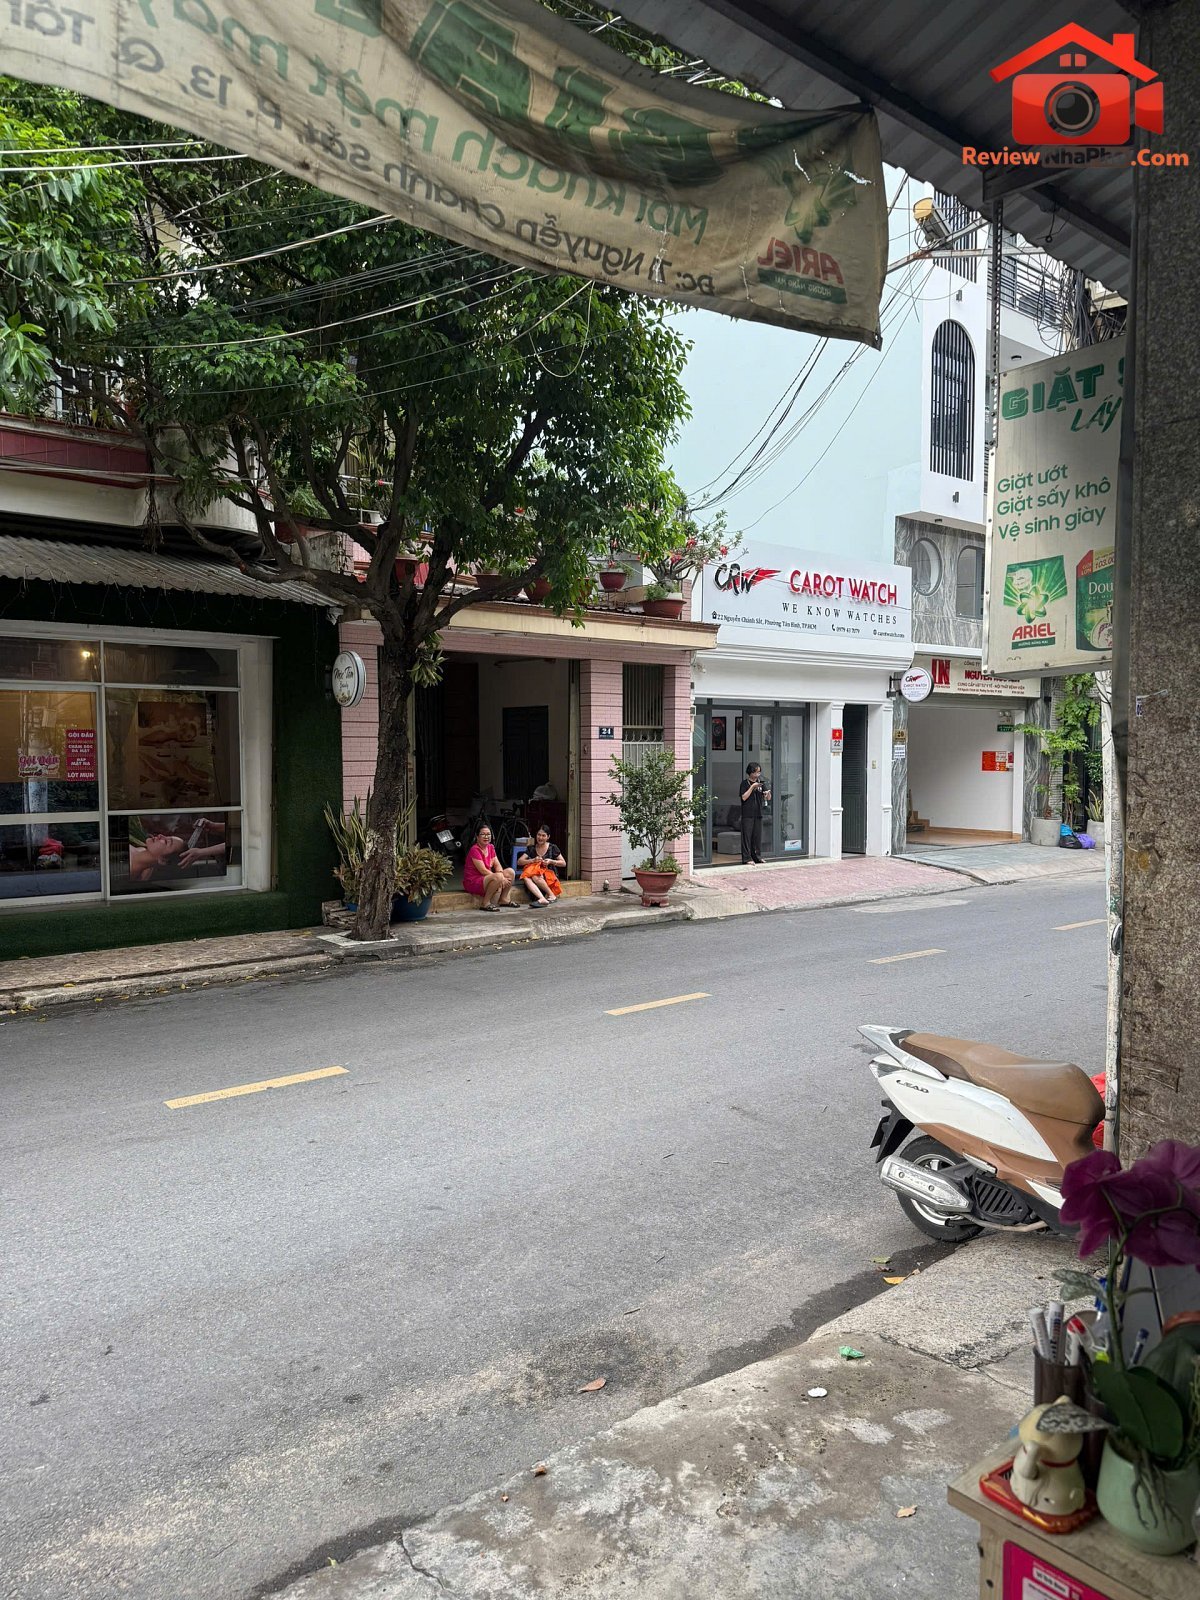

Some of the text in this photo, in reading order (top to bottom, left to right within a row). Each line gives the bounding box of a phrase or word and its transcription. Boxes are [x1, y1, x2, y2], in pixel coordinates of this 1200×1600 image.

[1002, 363, 1105, 420] GIẶT
[997, 464, 1068, 494] Giặt ướt
[997, 476, 1111, 516] Giặt sấy khô
[998, 506, 1106, 542] Vệ sinh giày
[790, 570, 897, 605] CAROT WATCH
[782, 602, 897, 624] WE KNOW WATCHES
[1012, 623, 1055, 640] ARIEL
